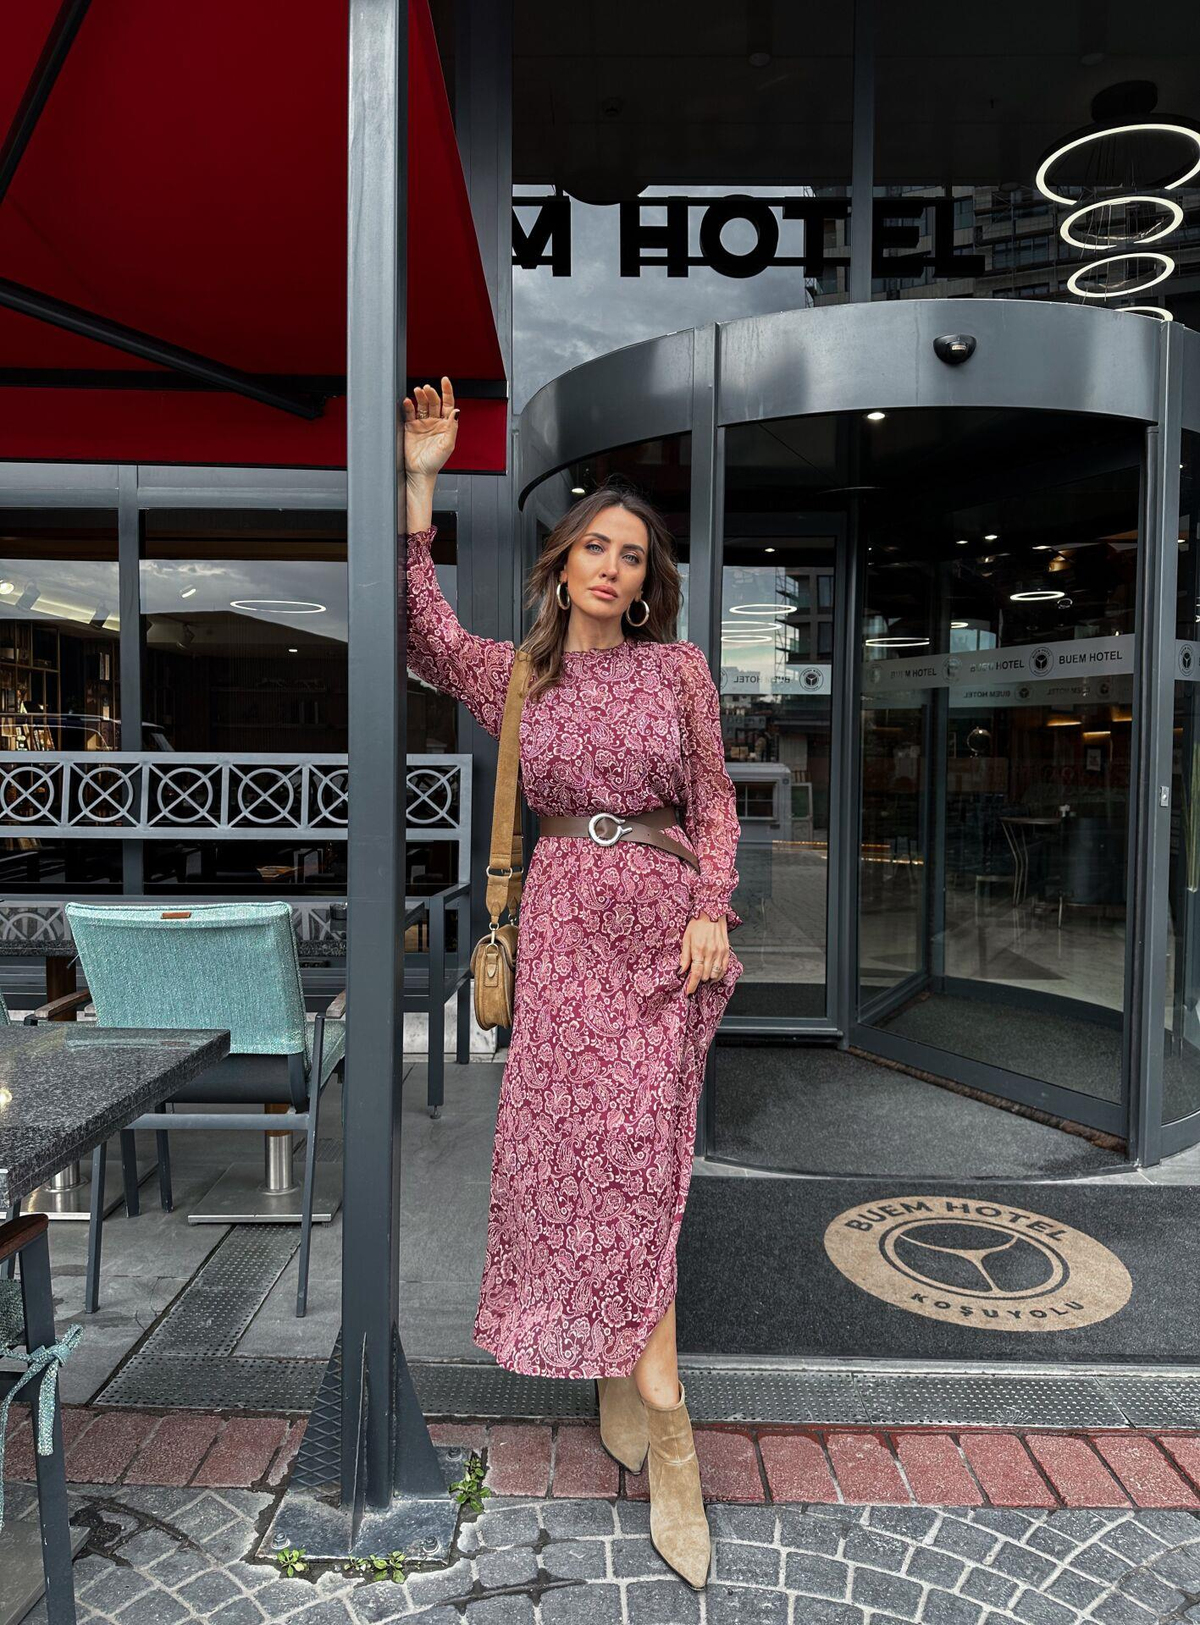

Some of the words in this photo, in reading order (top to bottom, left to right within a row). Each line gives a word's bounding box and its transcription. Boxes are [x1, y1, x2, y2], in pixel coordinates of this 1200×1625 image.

[620, 194, 985, 279] HOTEL
[995, 660, 1025, 670] HOTEL
[1058, 653, 1086, 665] BUEM
[1089, 650, 1123, 662] HOTEL
[912, 667, 937, 678] HOTEL
[844, 1201, 934, 1232] BUEM
[945, 1201, 1068, 1242] HOTEL
